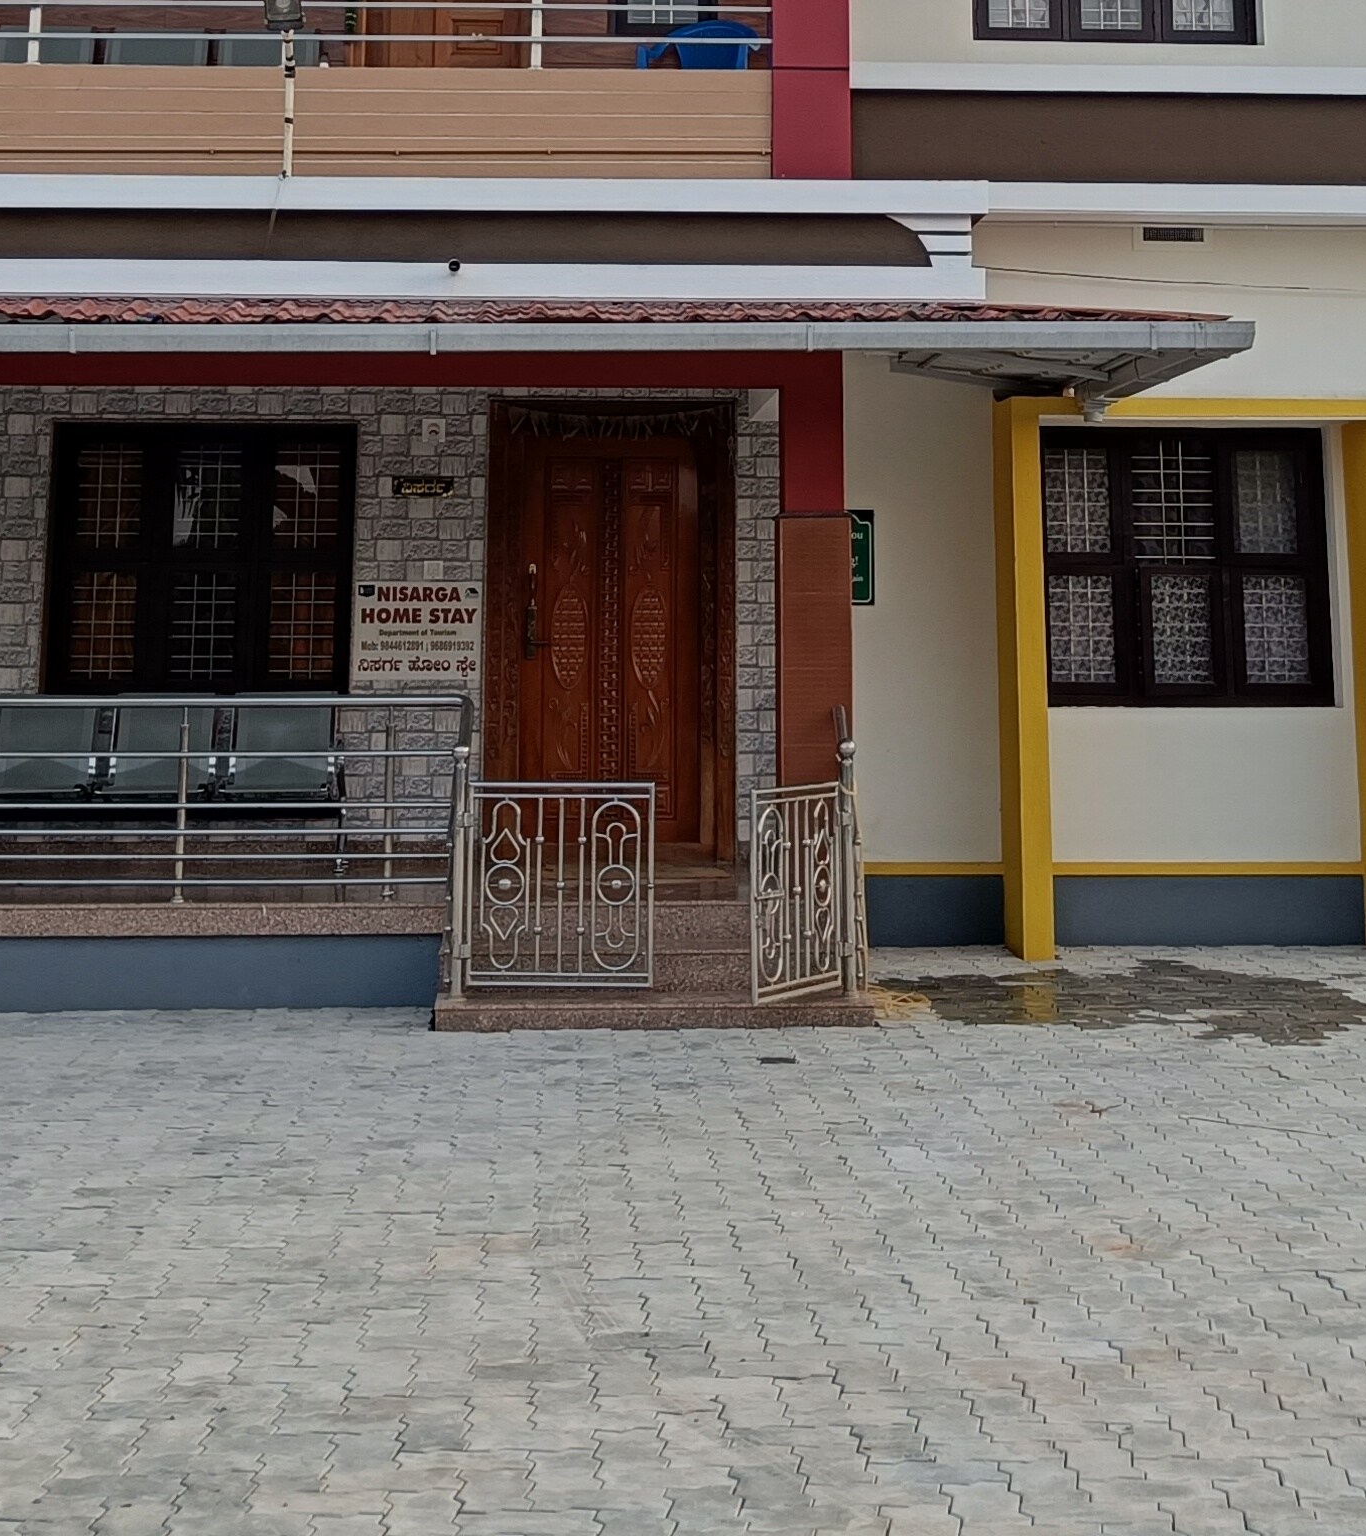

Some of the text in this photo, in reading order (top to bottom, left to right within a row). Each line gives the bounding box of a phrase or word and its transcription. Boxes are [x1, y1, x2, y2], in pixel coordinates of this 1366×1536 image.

[377, 586, 462, 602] NISARGA
[360, 608, 478, 624] HOME STAY
[378, 629, 419, 638] Department
[358, 657, 403, 672] ನಿಸರ್ಗ
[408, 655, 451, 672] ಹೋಂ
